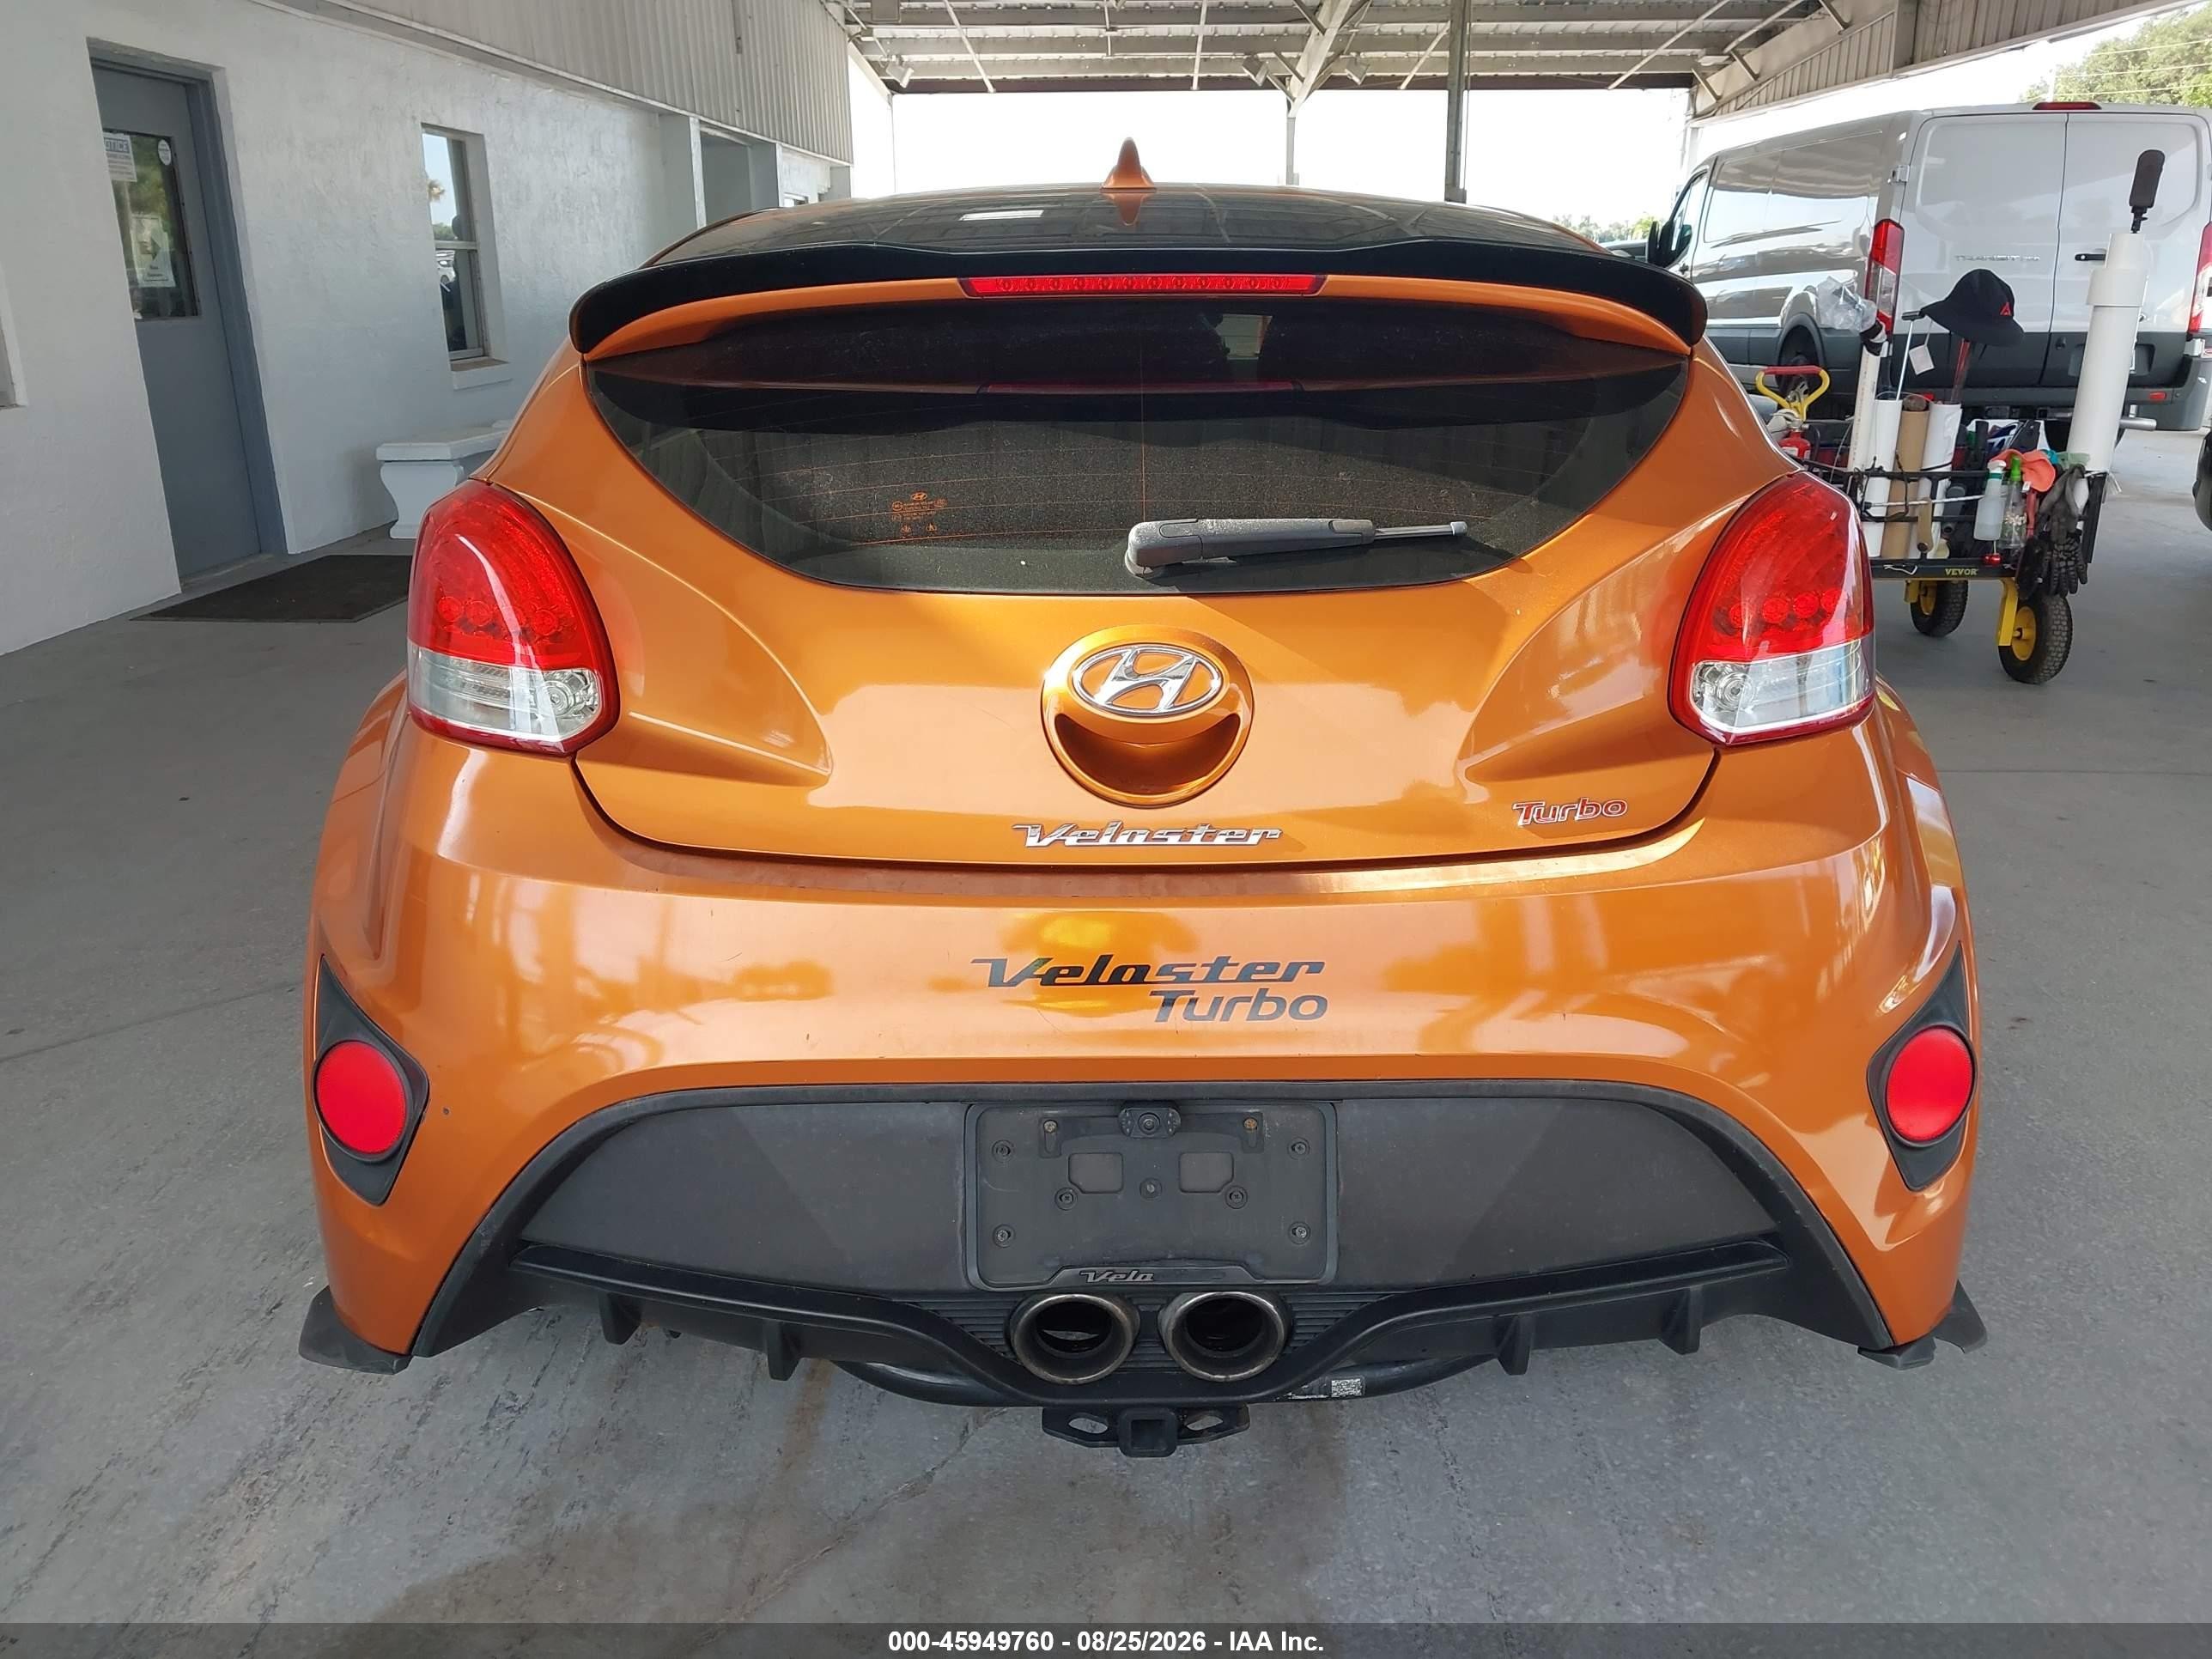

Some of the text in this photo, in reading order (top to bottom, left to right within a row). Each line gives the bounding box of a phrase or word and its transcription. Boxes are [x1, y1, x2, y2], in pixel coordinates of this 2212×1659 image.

[1512, 797, 1628, 827] Turbo
[1012, 820, 1282, 847] Veloster
[970, 954, 1327, 988] Veloster
[1148, 988, 1328, 1023] Turbo
